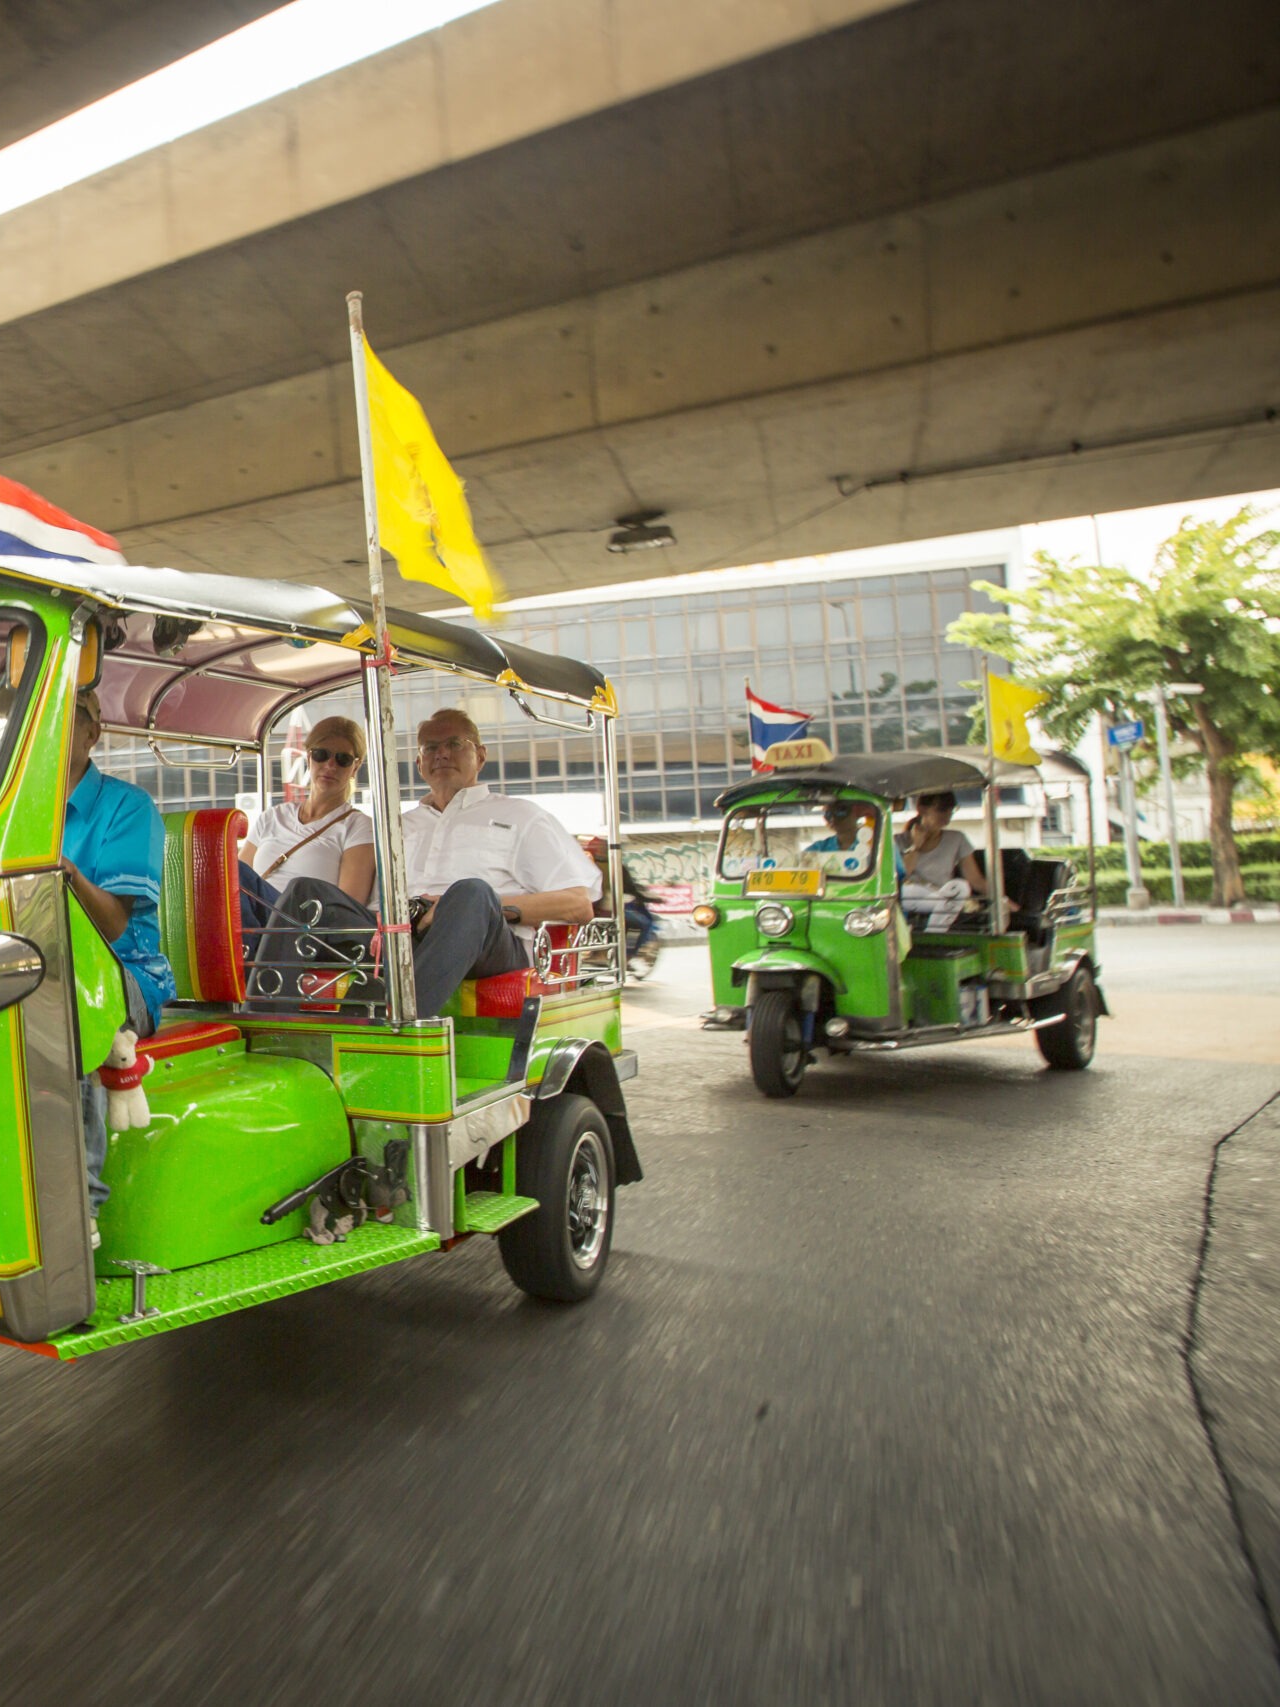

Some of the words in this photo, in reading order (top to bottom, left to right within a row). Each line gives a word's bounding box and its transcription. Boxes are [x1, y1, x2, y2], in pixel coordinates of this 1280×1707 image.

[770, 743, 813, 761] TAXI
[790, 871, 808, 885] 79
[120, 1074, 138, 1084] LOVE
